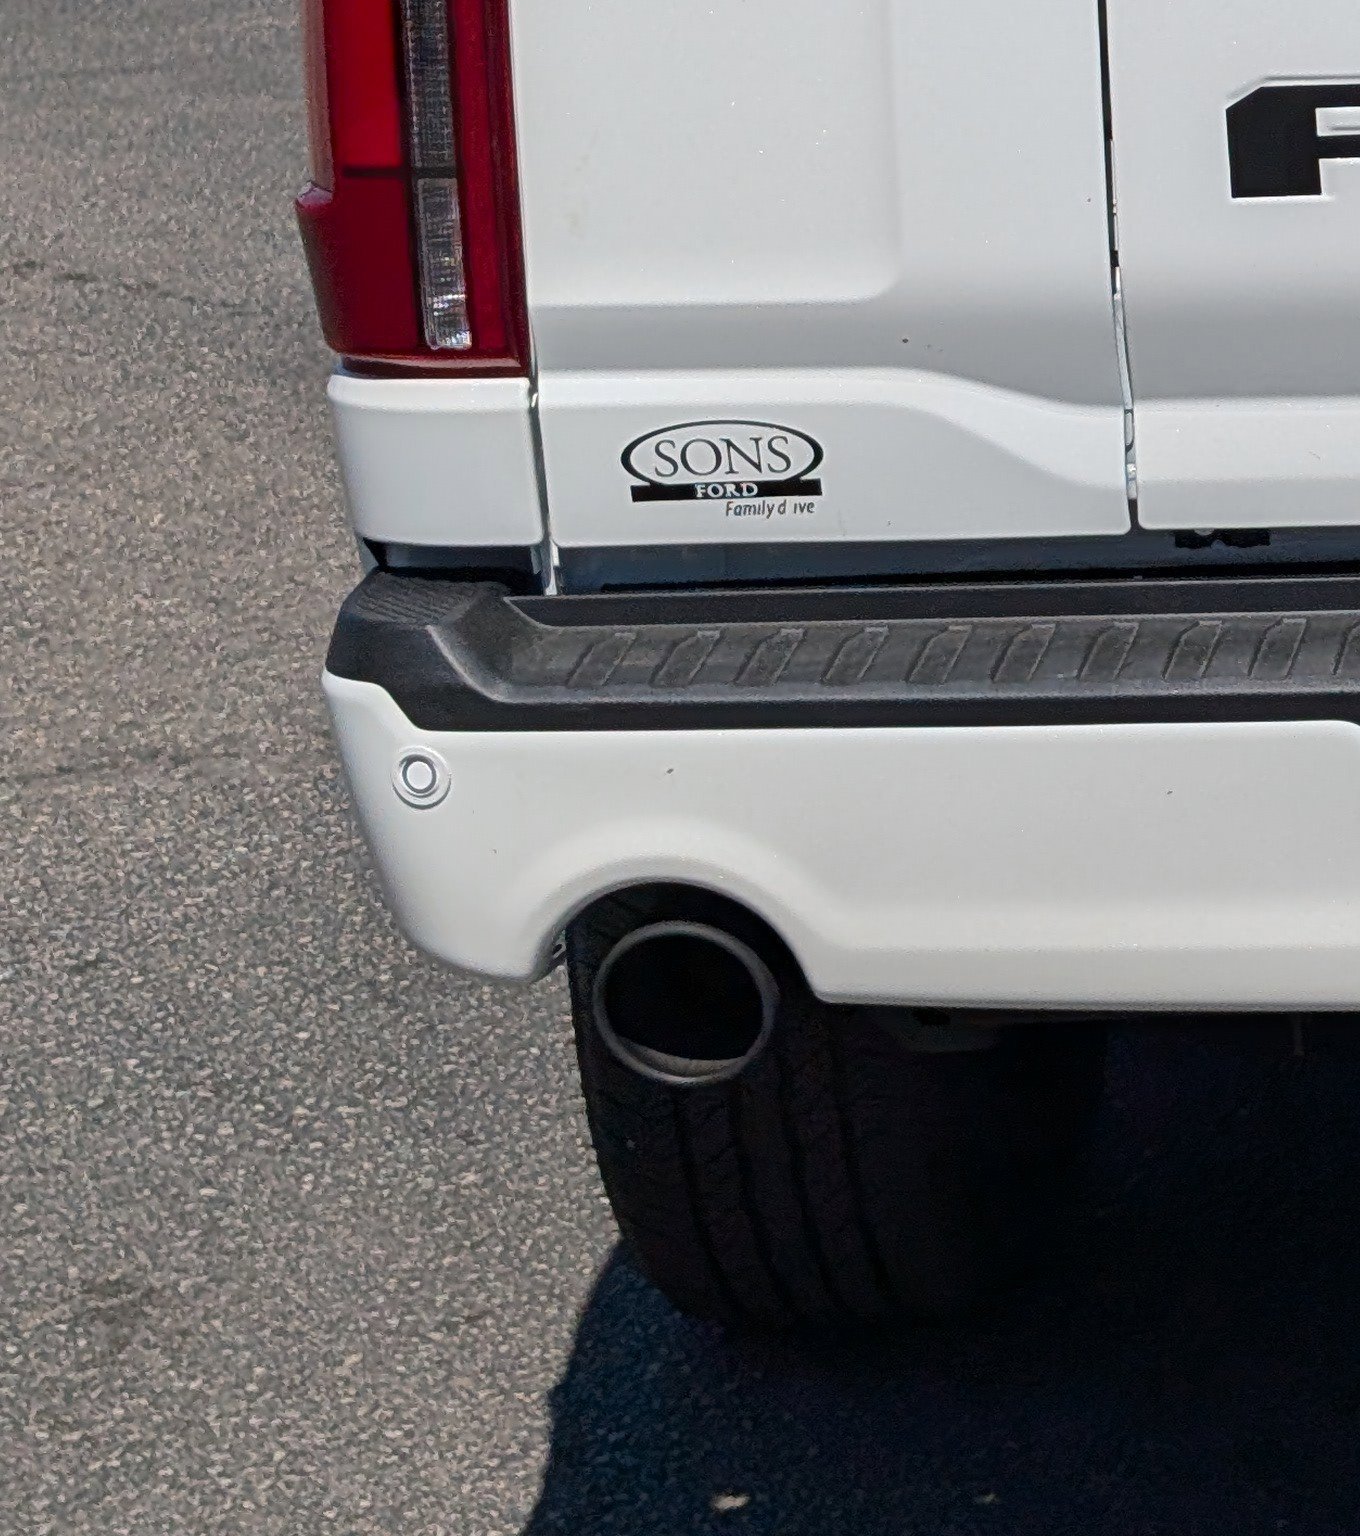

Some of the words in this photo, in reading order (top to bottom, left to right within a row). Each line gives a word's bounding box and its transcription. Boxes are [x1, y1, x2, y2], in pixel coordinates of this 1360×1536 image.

[653, 435, 791, 478] SONS
[694, 482, 758, 498] FORD
[725, 500, 775, 518] Family
[777, 499, 815, 514] dive
